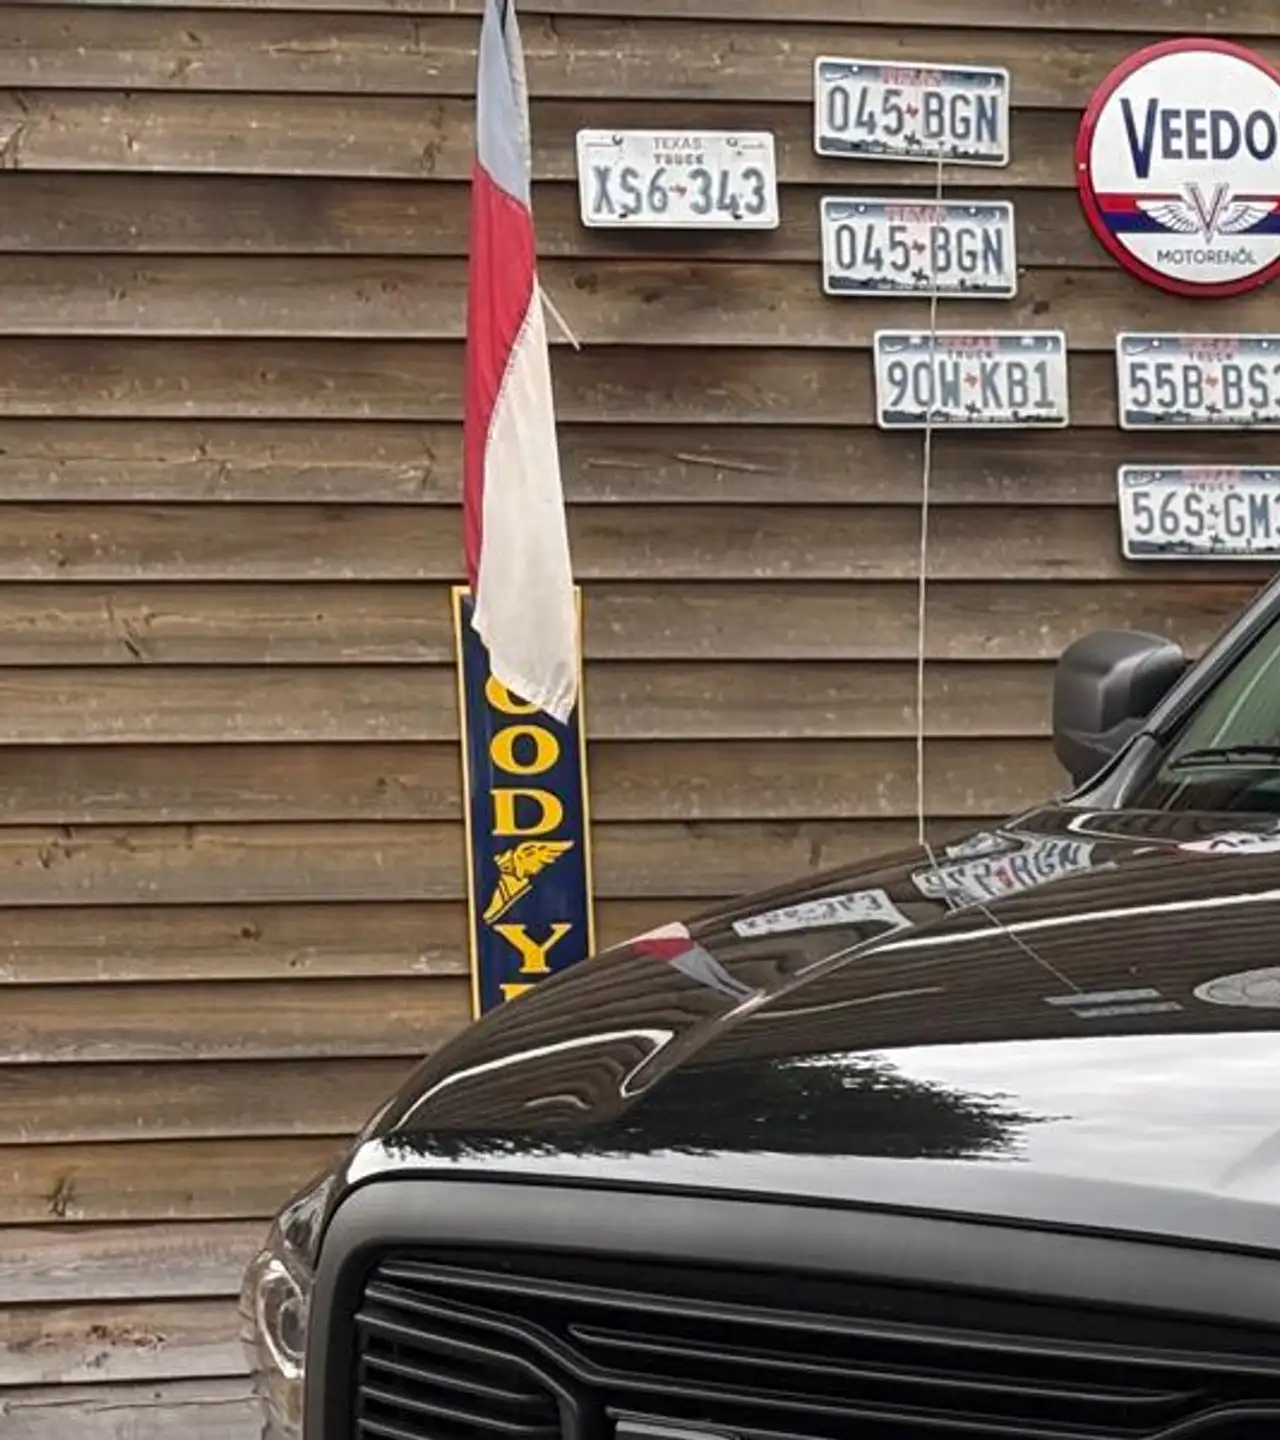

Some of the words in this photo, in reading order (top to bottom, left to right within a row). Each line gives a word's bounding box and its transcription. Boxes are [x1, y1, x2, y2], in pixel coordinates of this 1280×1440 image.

[924, 90, 998, 143] BGN
[653, 136, 704, 151] TEXAS
[592, 165, 669, 215] XS6
[687, 167, 766, 215] 343
[930, 226, 1004, 274] BGN
[979, 360, 1054, 408] KB1
[1129, 362, 1204, 409] 55B
[1132, 491, 1204, 537] 56S
